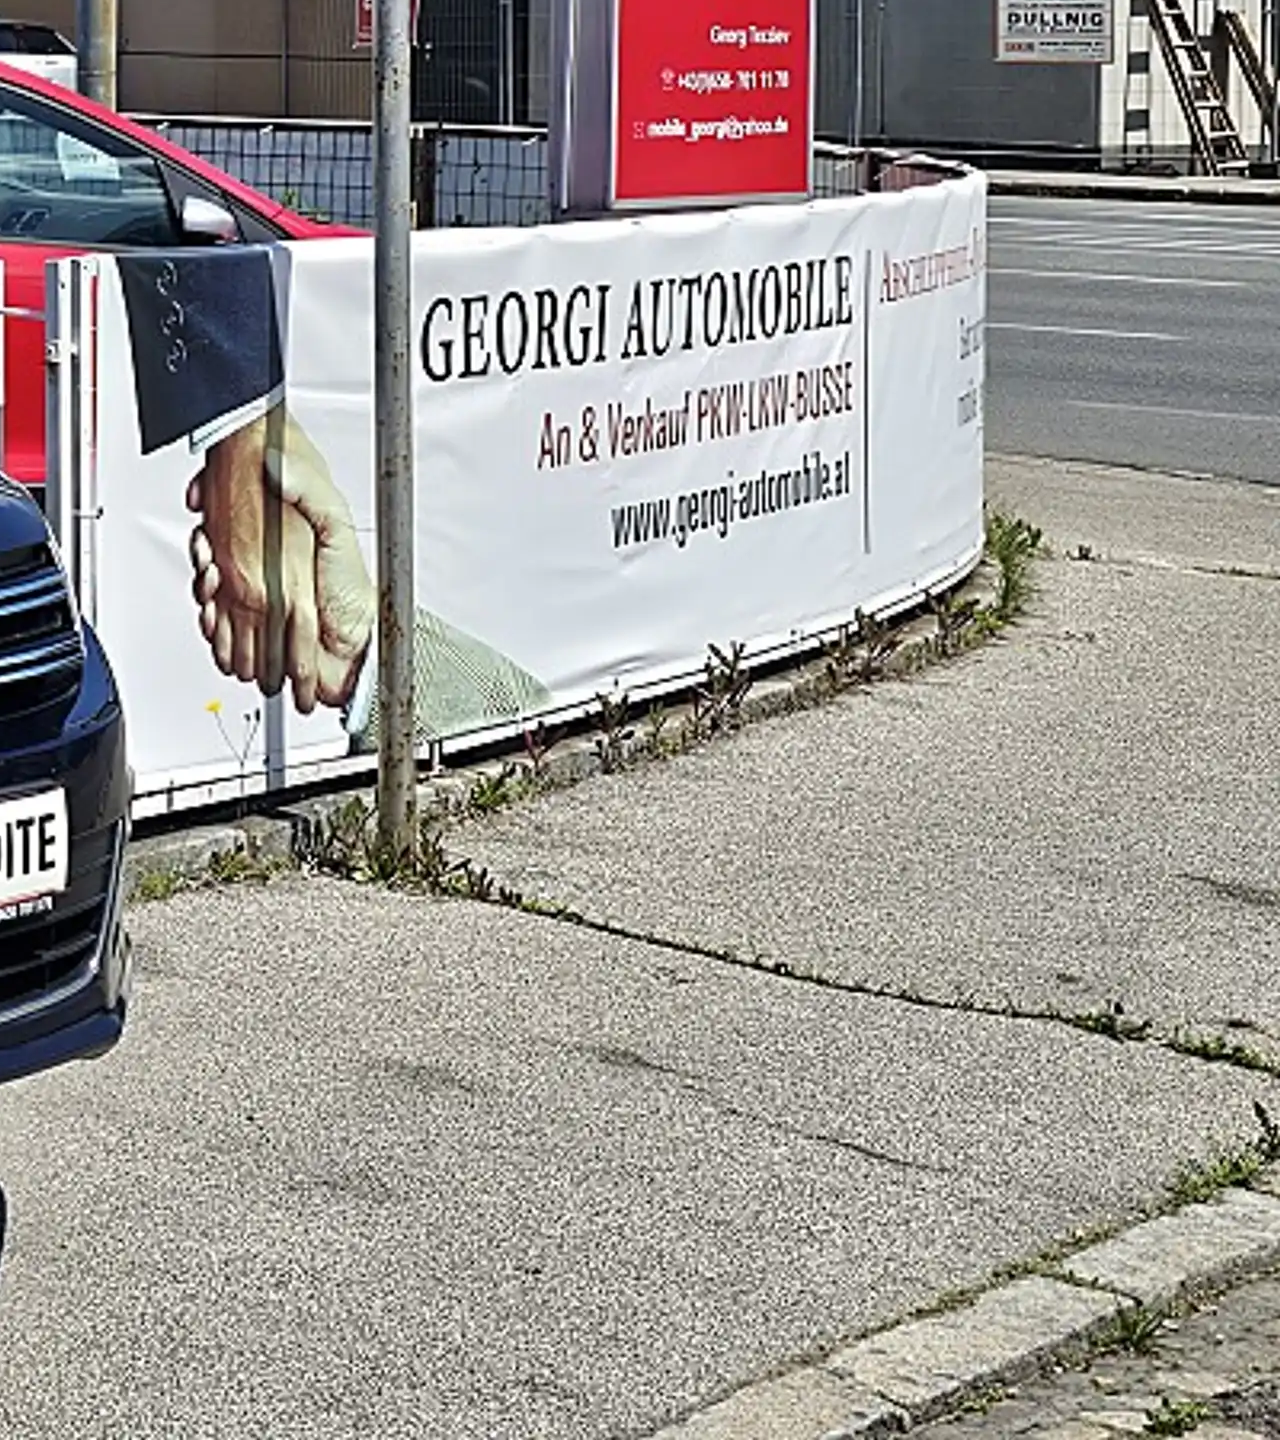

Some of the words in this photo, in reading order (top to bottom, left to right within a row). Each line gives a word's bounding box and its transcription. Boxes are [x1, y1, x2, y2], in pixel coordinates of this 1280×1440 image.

[421, 285, 611, 382] GEORGI
[621, 255, 852, 360] AUTOMOBILE
[537, 412, 571, 470] An
[579, 406, 599, 462] &
[608, 390, 691, 459] Verkauf
[697, 361, 853, 442] PKW-LKW-BUSSE
[611, 450, 850, 549] www.georgi-automobile.at
